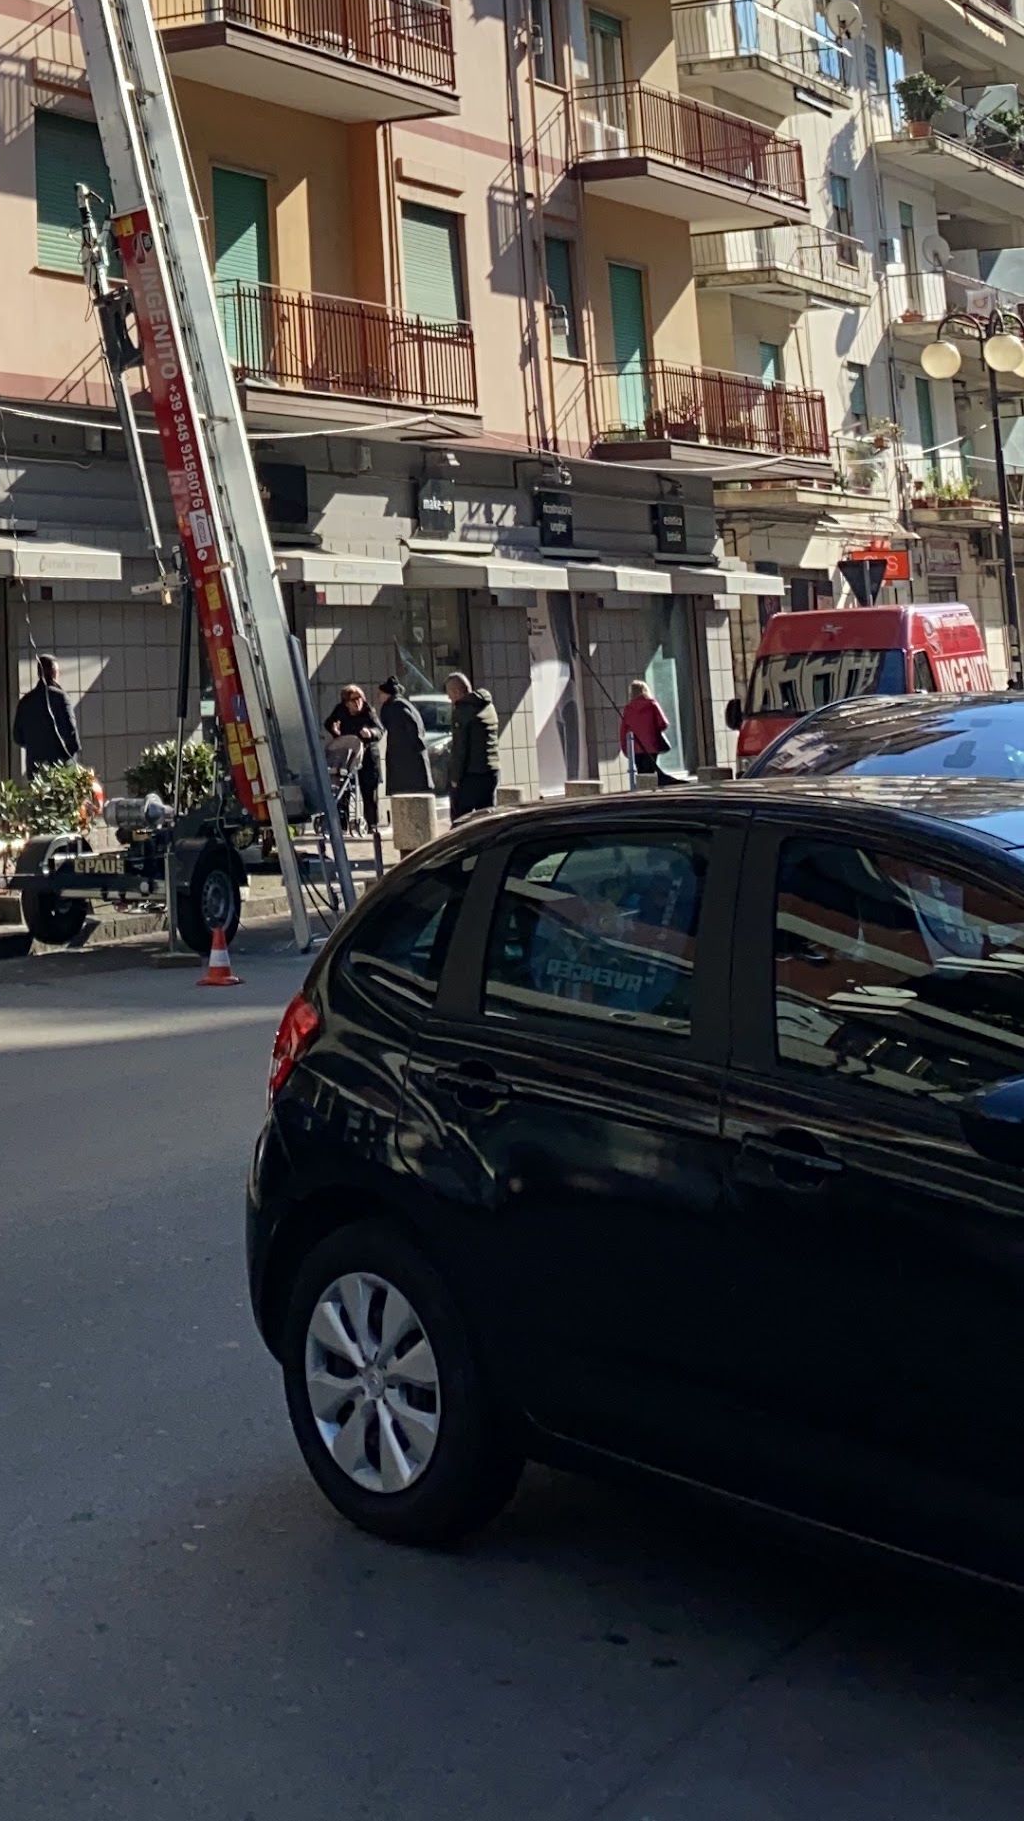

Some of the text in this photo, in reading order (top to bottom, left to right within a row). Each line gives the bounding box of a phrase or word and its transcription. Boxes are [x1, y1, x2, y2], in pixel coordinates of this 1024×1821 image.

[139, 267, 178, 379] INGENITO
[169, 384, 183, 411] +39
[174, 413, 190, 442] 348
[180, 443, 204, 509] 9156076
